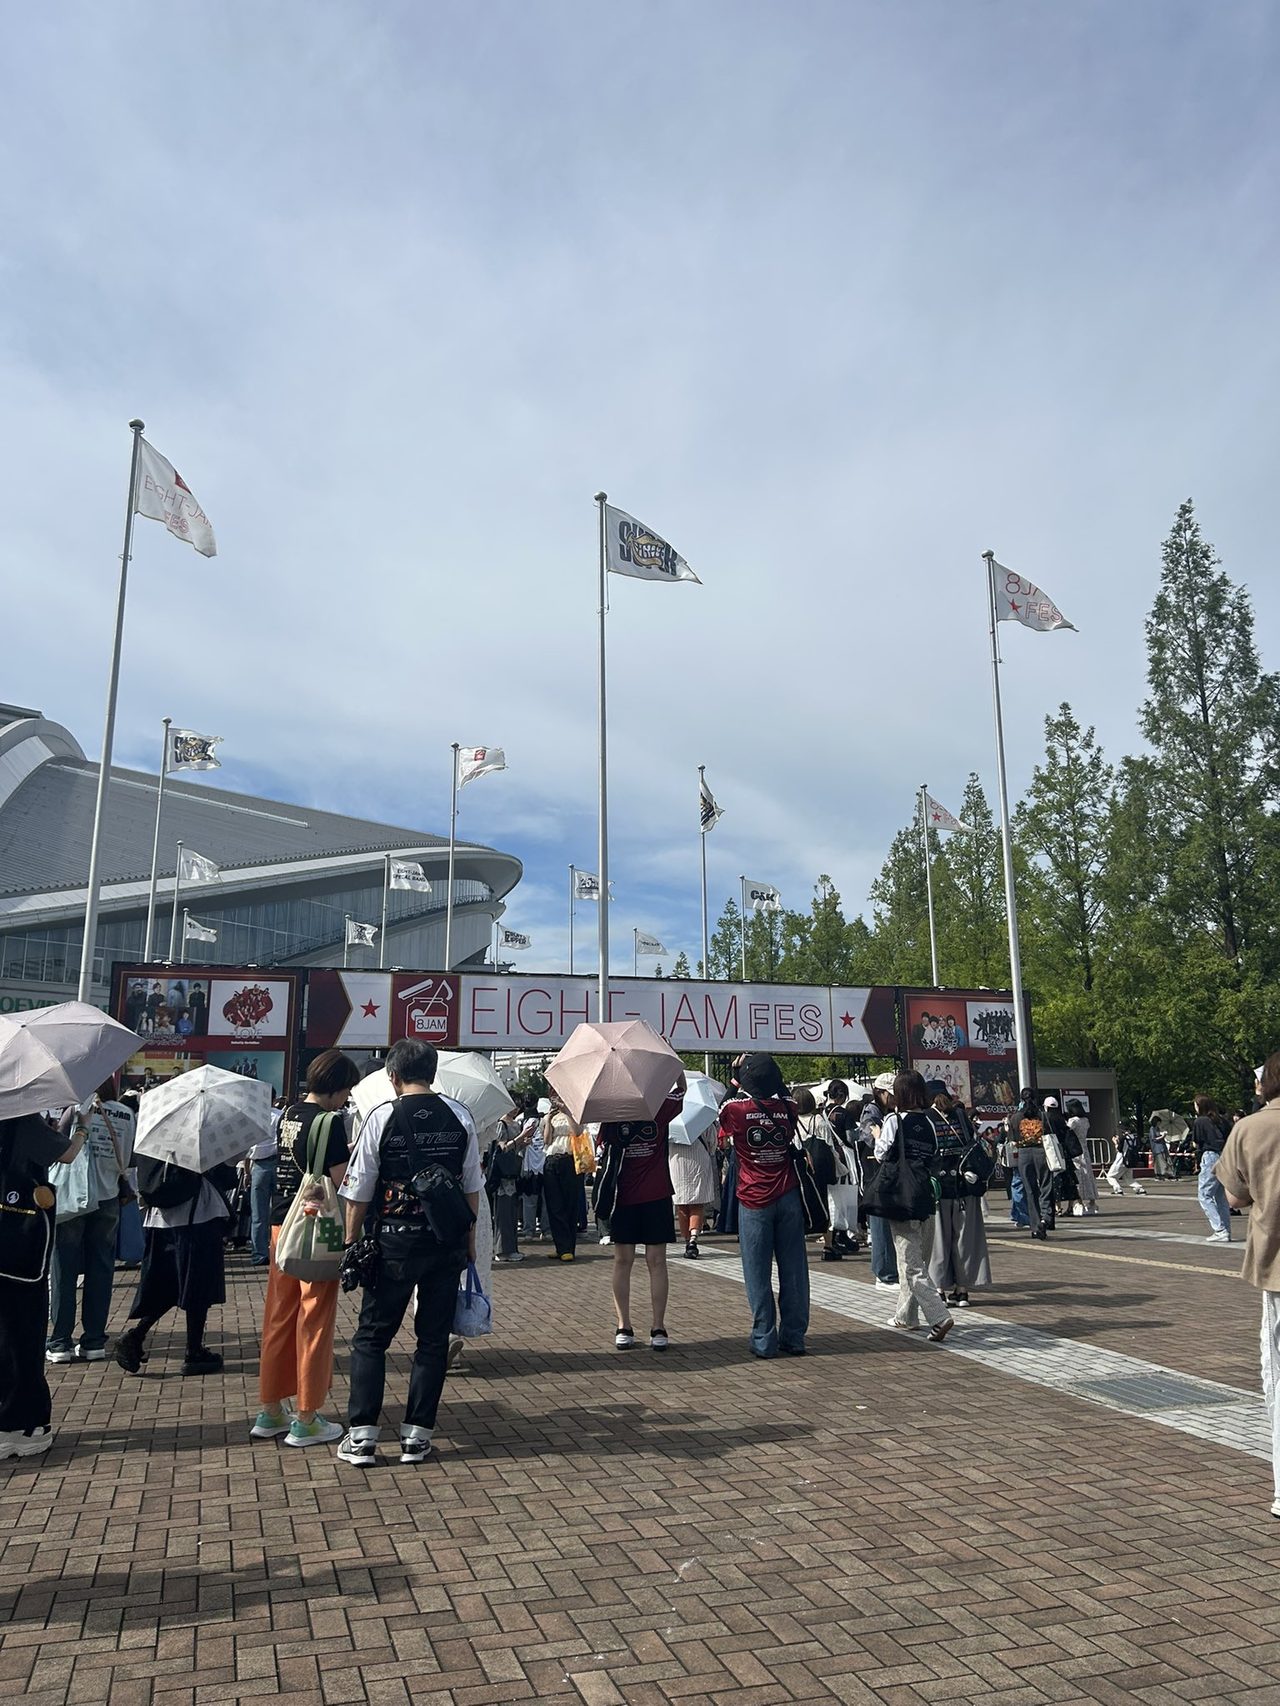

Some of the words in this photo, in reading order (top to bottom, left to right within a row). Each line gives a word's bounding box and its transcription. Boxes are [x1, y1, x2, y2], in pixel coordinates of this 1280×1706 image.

[1025, 602, 1063, 622] FES
[416, 1018, 446, 1030] 8JAM
[471, 986, 739, 1040] EIGHT-JAM
[749, 1003, 824, 1042] FES
